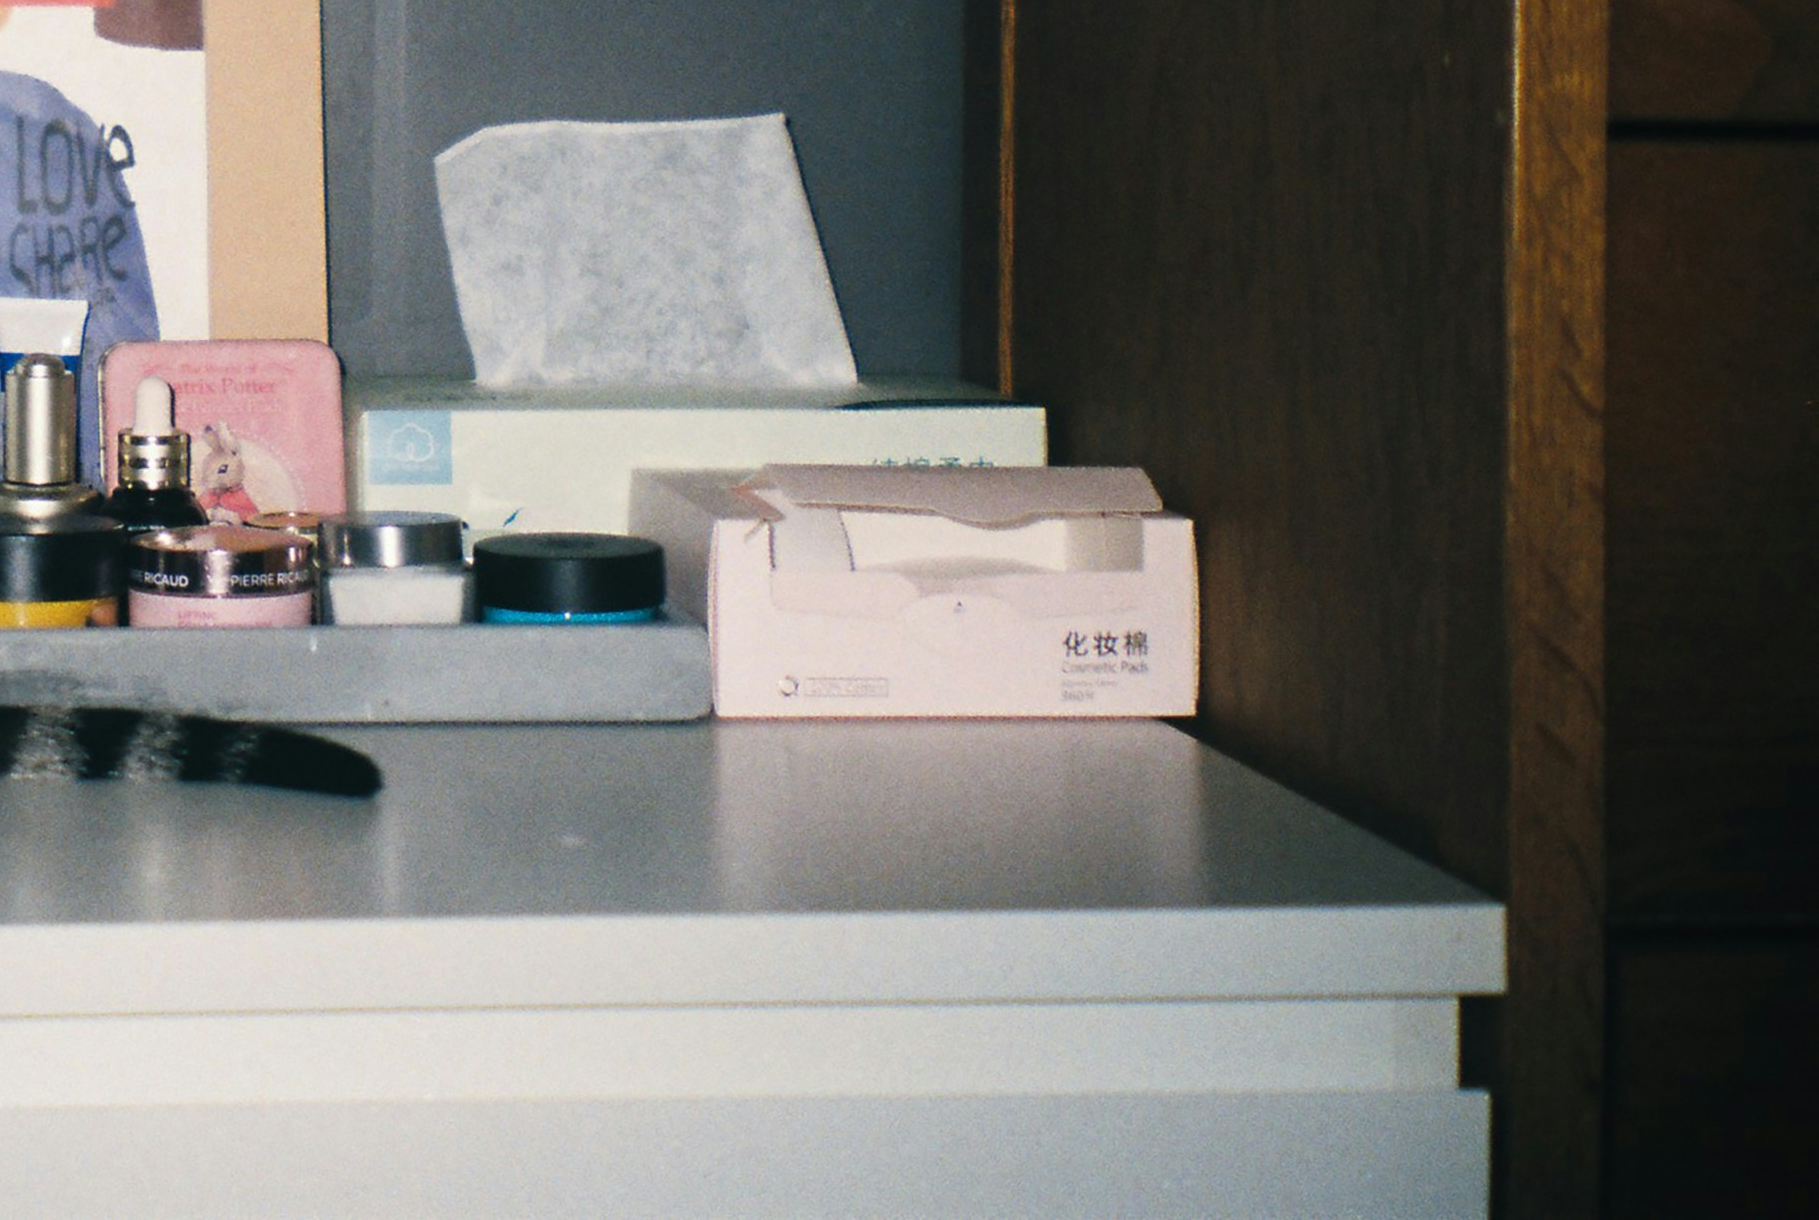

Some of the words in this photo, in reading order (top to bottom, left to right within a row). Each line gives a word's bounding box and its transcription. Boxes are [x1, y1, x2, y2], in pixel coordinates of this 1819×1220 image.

[144, 571, 190, 587] RICAUD
[230, 573, 275, 587] PIERRE
[1062, 630, 1149, 658] 化妆棉
